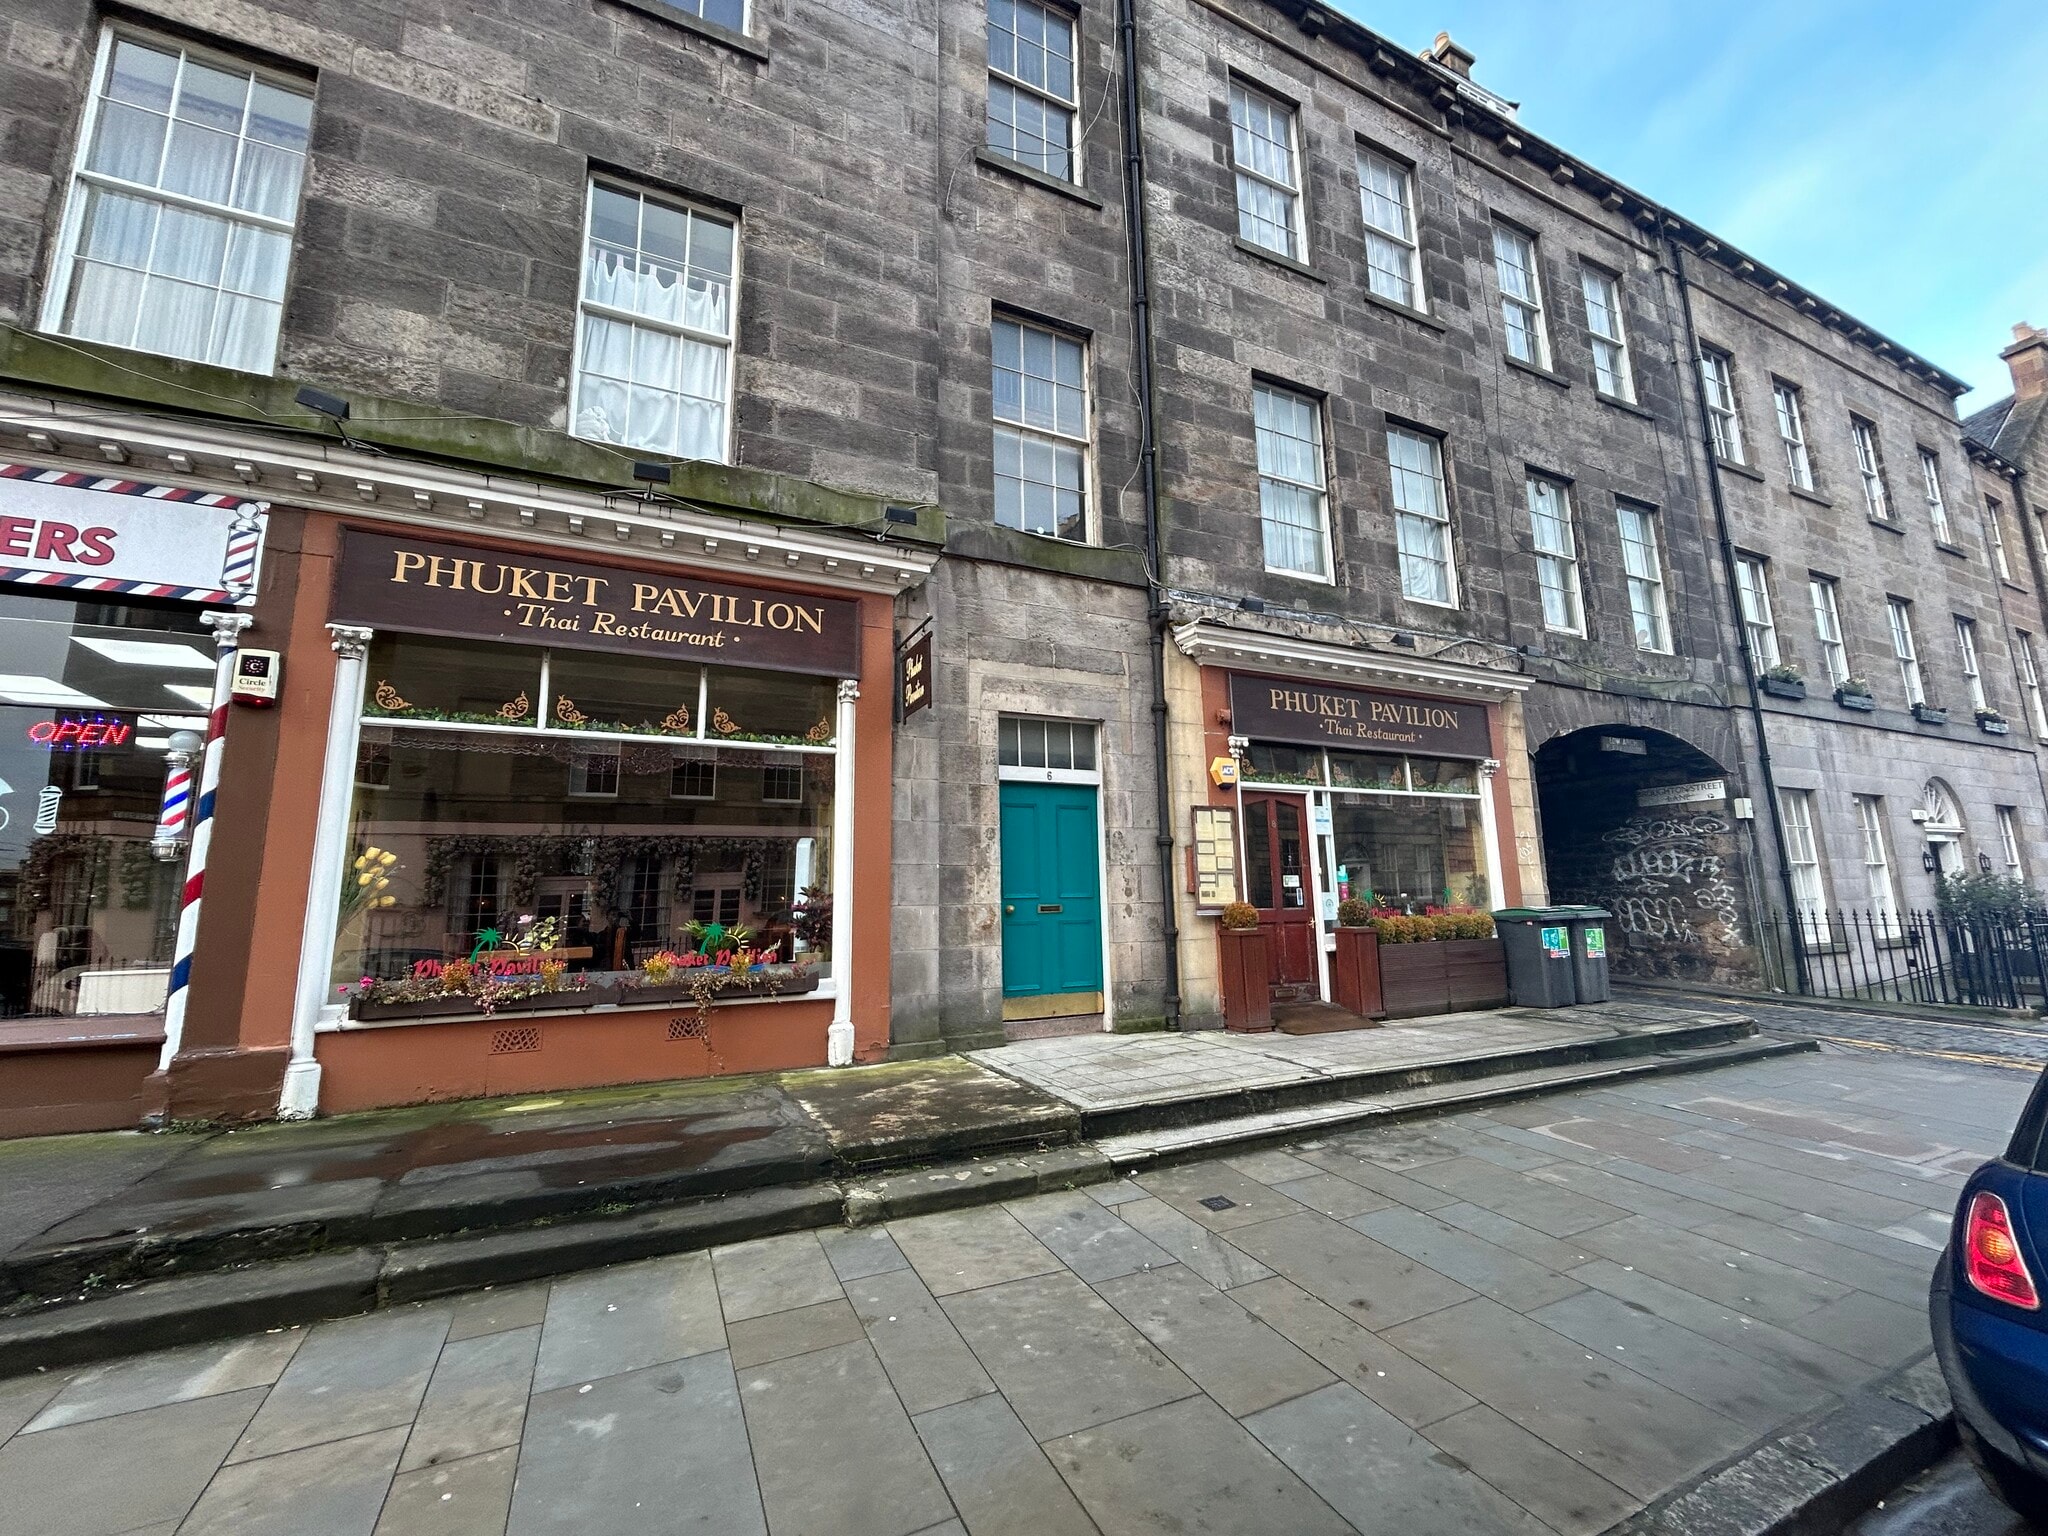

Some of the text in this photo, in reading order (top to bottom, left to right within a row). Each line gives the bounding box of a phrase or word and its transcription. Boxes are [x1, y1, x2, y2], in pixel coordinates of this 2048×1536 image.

[390, 550, 824, 634] PHUKET PAVILION
[517, 602, 726, 648] Thai Restaurant
[239, 678, 266, 686] Circle
[1270, 688, 1459, 730] PHUKET PAVILION
[27, 721, 131, 745] OPEN
[1325, 718, 1416, 743] Thai Restaurant
[1046, 771, 1053, 781] 6
[1689, 781, 1723, 792] STREET
